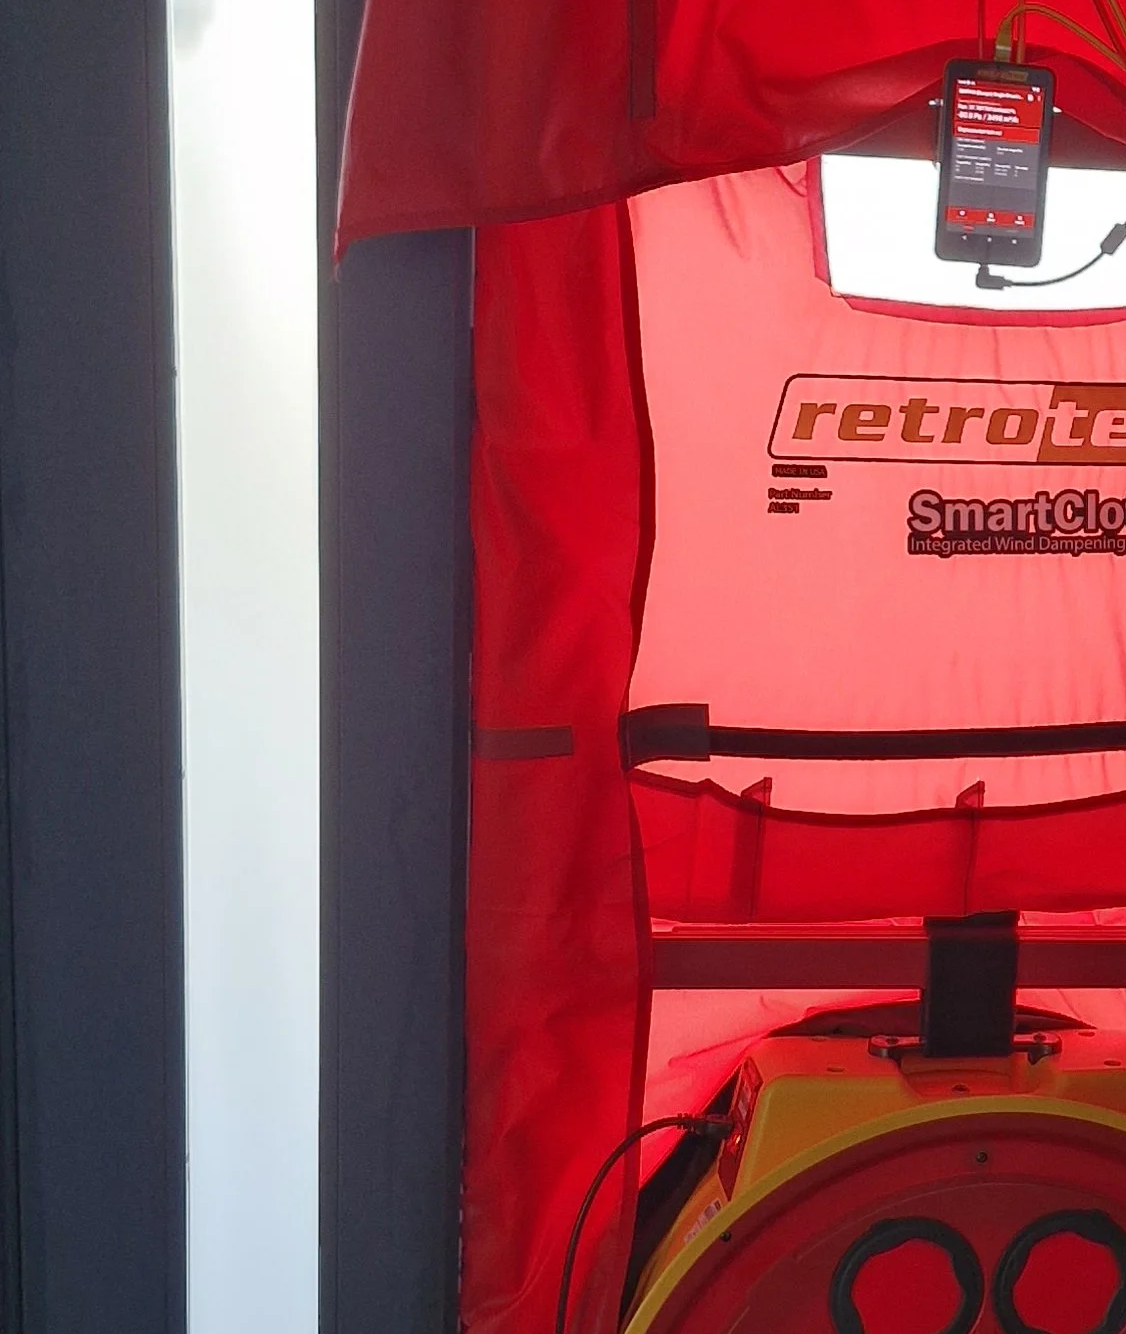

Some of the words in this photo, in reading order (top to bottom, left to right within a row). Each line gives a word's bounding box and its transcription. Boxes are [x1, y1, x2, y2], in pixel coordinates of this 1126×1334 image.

[769, 489, 789, 500] Part
[790, 489, 832, 500] Number
[911, 536, 992, 555] Integrated
[993, 535, 1035, 552] Wind
[1039, 535, 1126, 555] Dampening
